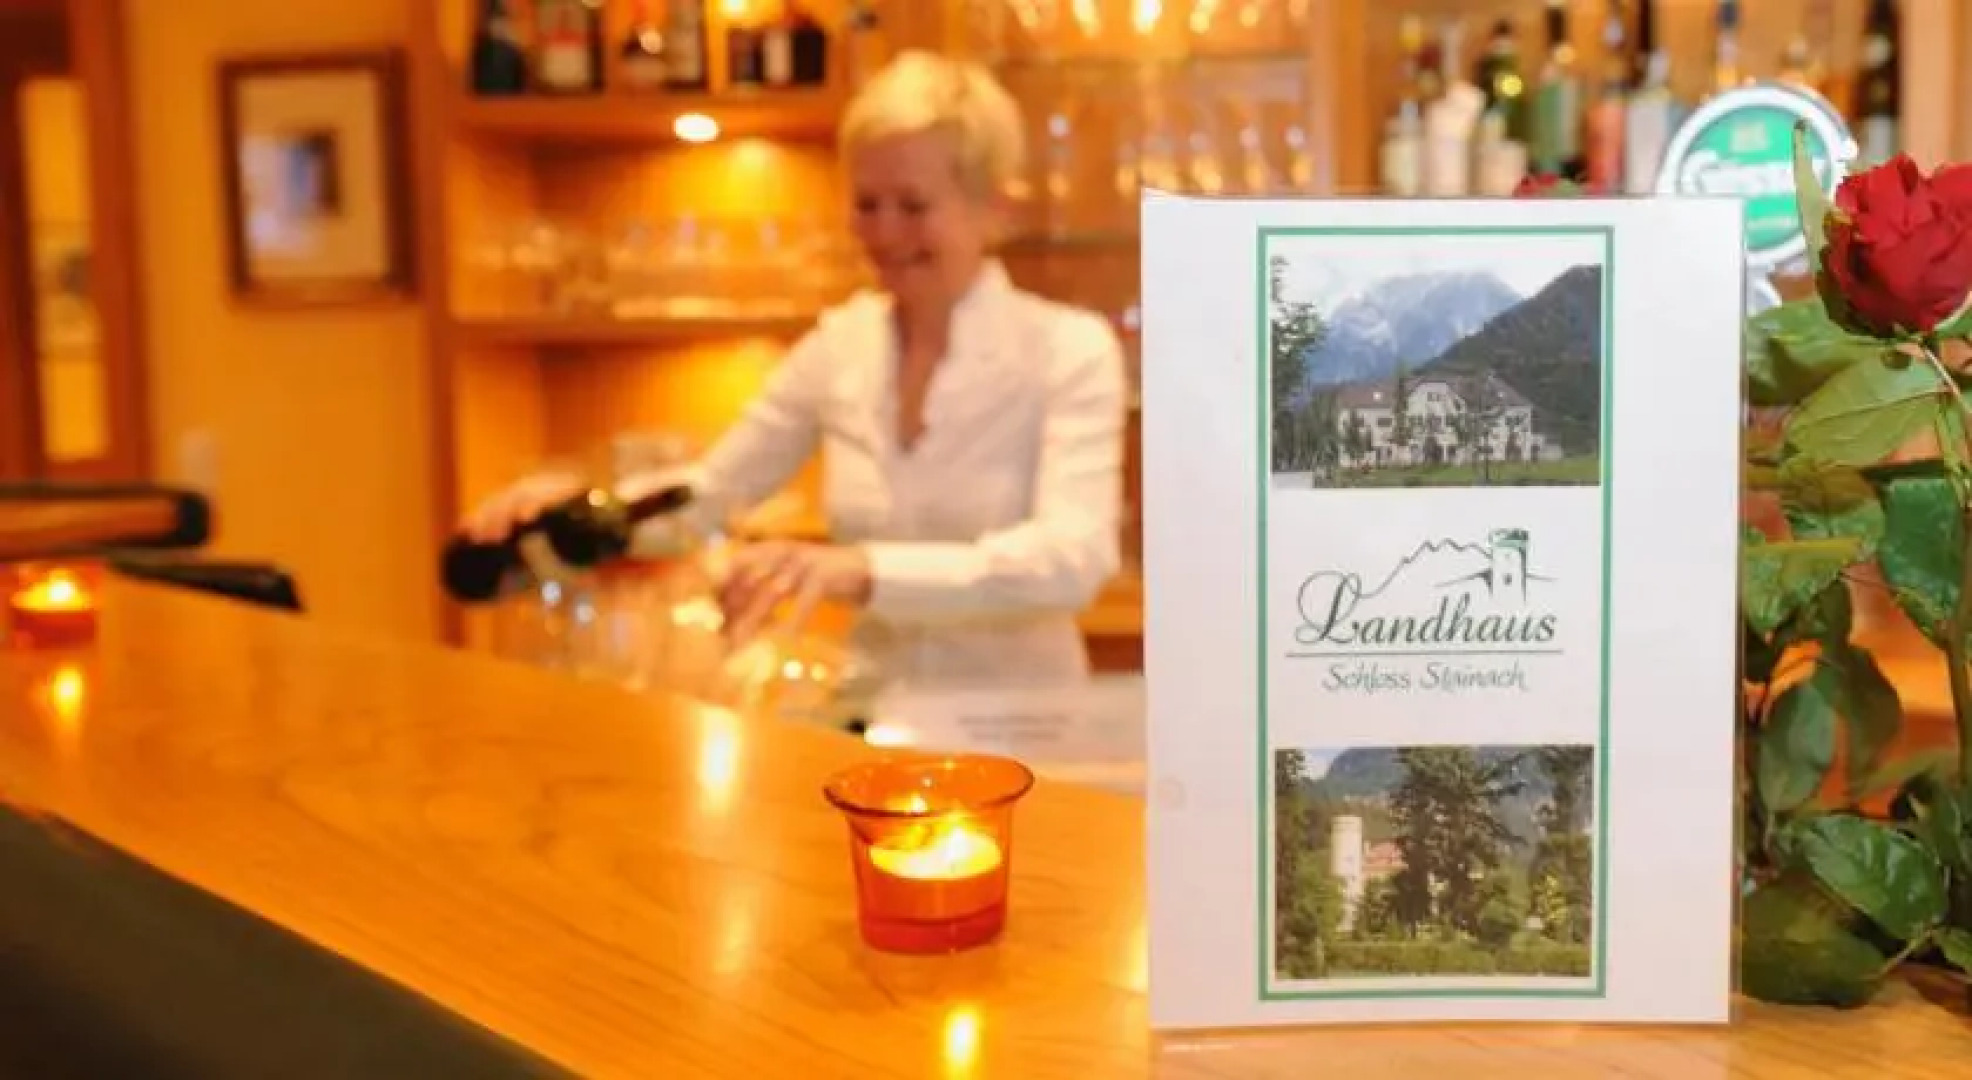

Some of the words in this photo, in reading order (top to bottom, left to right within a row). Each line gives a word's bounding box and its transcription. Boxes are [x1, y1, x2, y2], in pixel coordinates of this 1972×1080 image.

[1295, 571, 1558, 644] Landhaus
[1321, 661, 1411, 693] Schloss
[1420, 658, 1530, 692] Stainach
